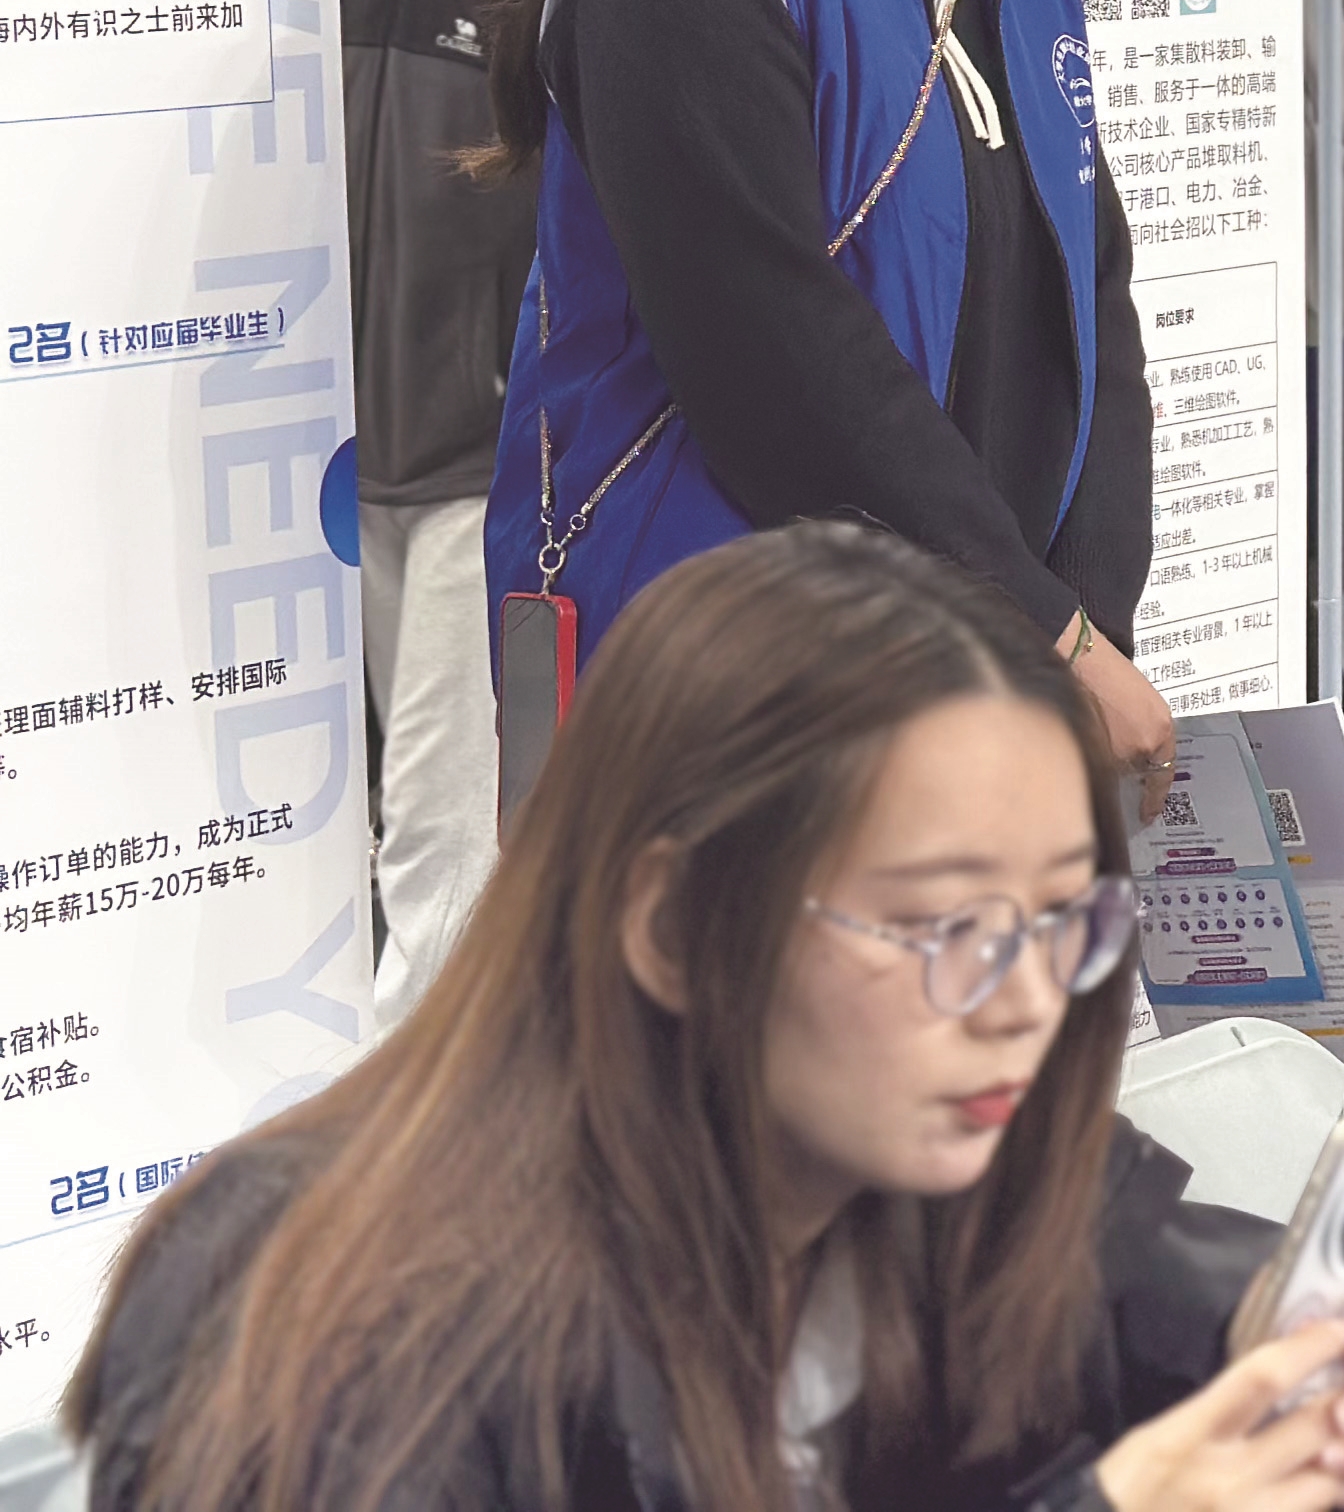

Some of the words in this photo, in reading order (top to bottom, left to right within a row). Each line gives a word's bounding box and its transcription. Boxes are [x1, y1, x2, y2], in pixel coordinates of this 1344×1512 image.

[1092, 35, 1276, 72] 年，是一家集散料装卸、输
[1107, 70, 1276, 108] 销售、服务于一体的高端
[1117, 175, 1269, 212] 于港口、电力、冶金、
[1156, 307, 1195, 329] 岗位要求
[0, 658, 287, 738] 理面辅料打样、安排国际
[0, 856, 265, 934] 均年薪15万-20万每年。
[3, 1059, 90, 1101] 公积金。
